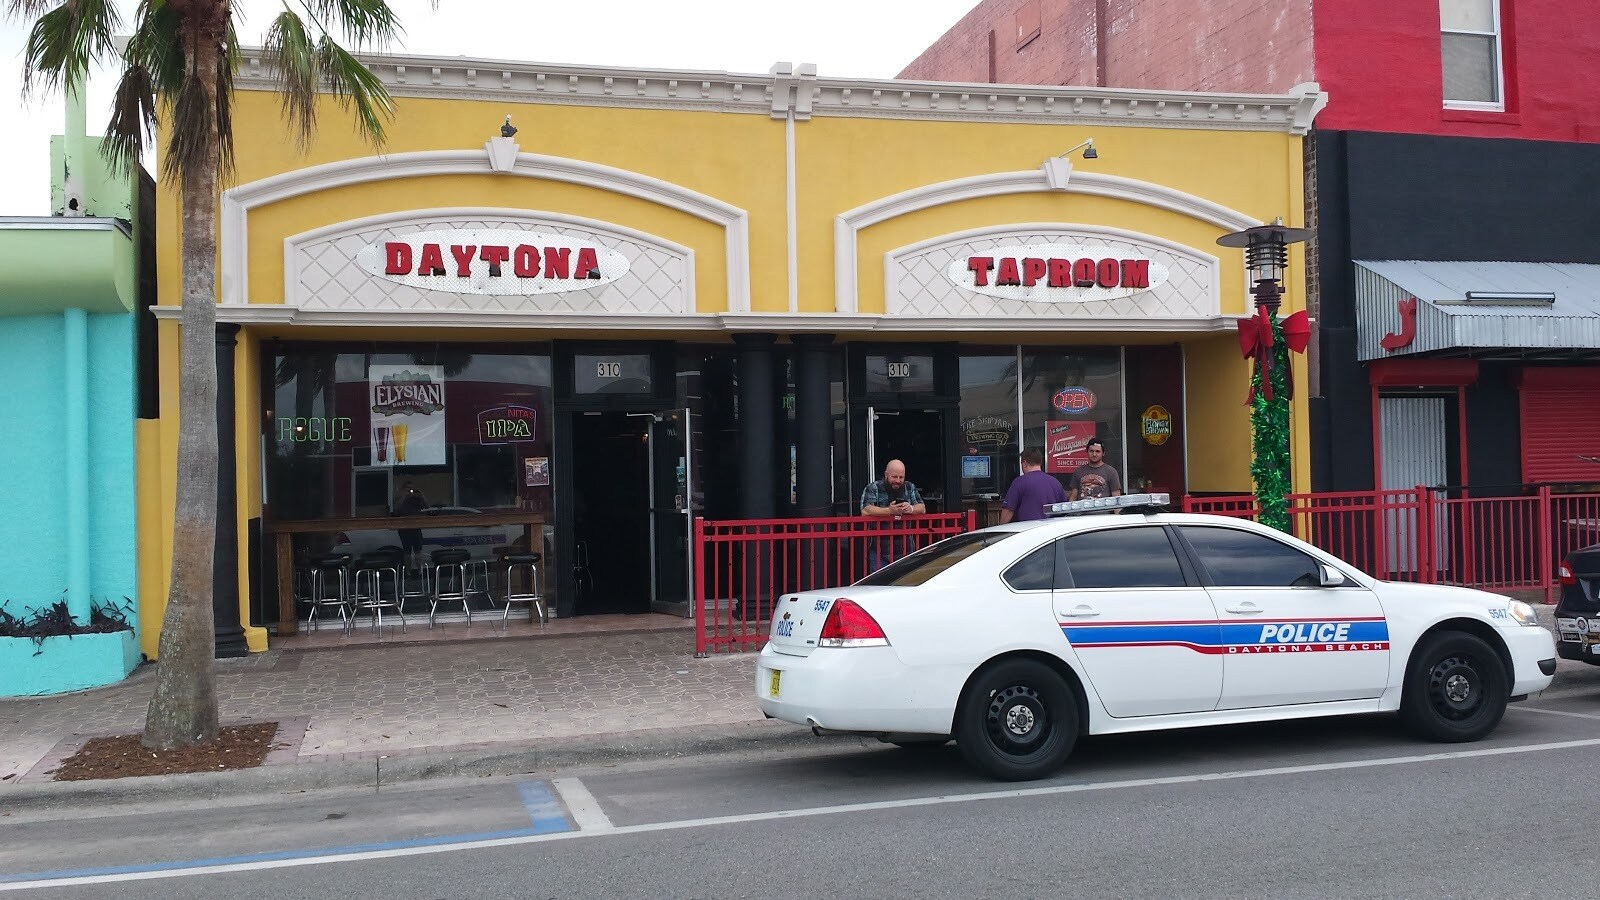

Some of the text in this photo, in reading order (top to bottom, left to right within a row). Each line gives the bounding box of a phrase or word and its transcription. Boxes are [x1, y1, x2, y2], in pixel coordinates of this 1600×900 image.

[385, 241, 601, 280] DAYTONA
[967, 256, 1150, 289] TAPROOM
[598, 363, 621, 377] 310
[889, 363, 909, 376] 310
[376, 383, 441, 406] ELYSIAN
[1052, 393, 1093, 408] OPEN
[392, 400, 424, 409] BREWING
[278, 417, 352, 442] ROGUE
[485, 418, 532, 437] IPA
[814, 599, 831, 611] 5547
[1488, 608, 1508, 620] 5547
[776, 620, 795, 637] POLICE
[1258, 623, 1352, 644] POLICE
[1228, 642, 1384, 655] DAYTONA BEACH
